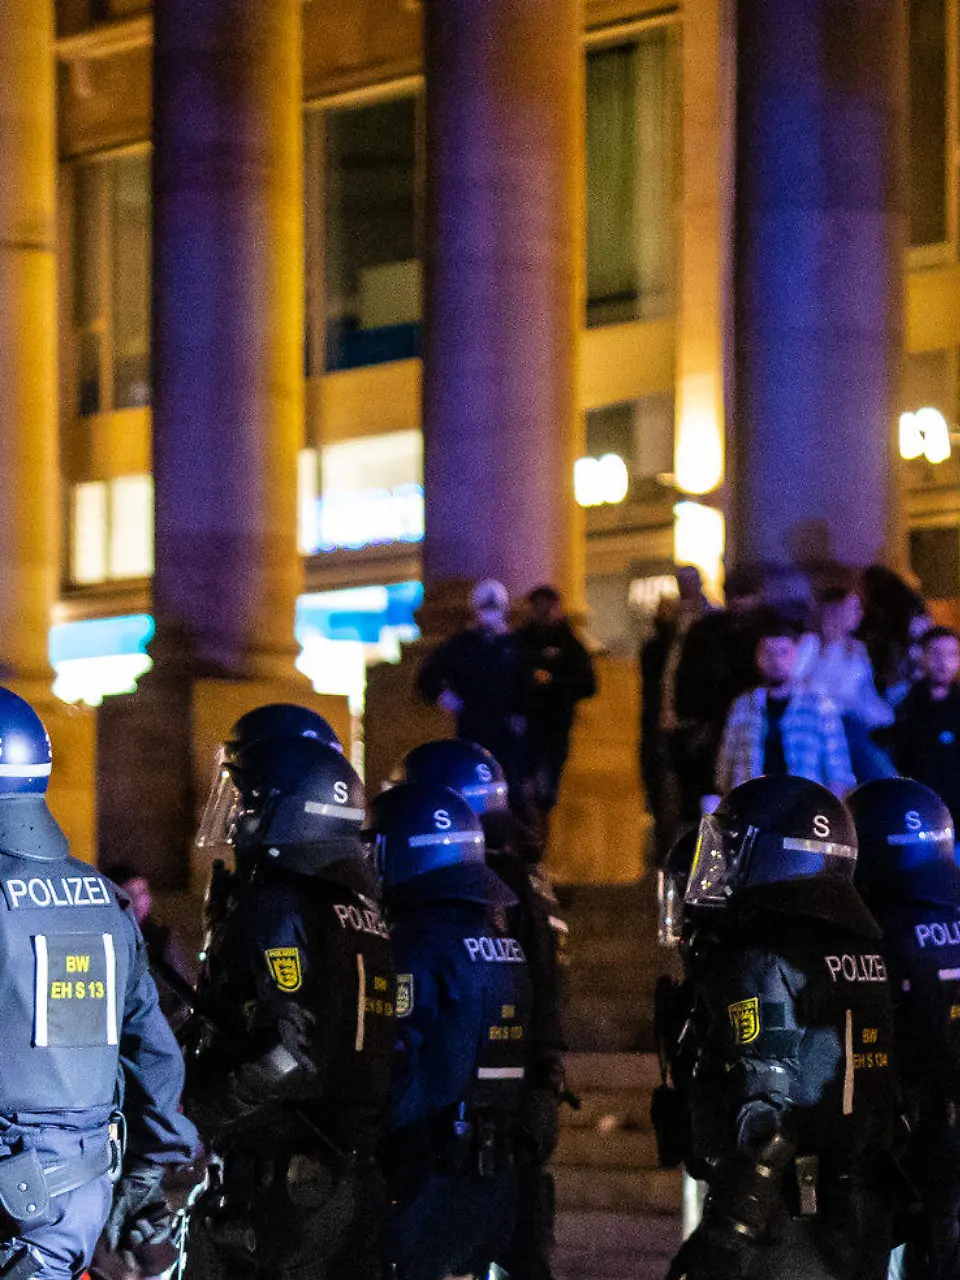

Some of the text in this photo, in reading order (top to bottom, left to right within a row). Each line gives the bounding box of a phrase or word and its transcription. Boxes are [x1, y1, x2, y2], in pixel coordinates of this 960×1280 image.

[475, 763, 493, 782] S
[332, 780, 350, 804] S
[433, 809, 452, 830] S
[813, 815, 830, 838] S
[904, 810, 922, 830] S
[6, 876, 112, 908] POLIZEI
[65, 955, 90, 973] BW
[51, 980, 105, 999] EH S 13
